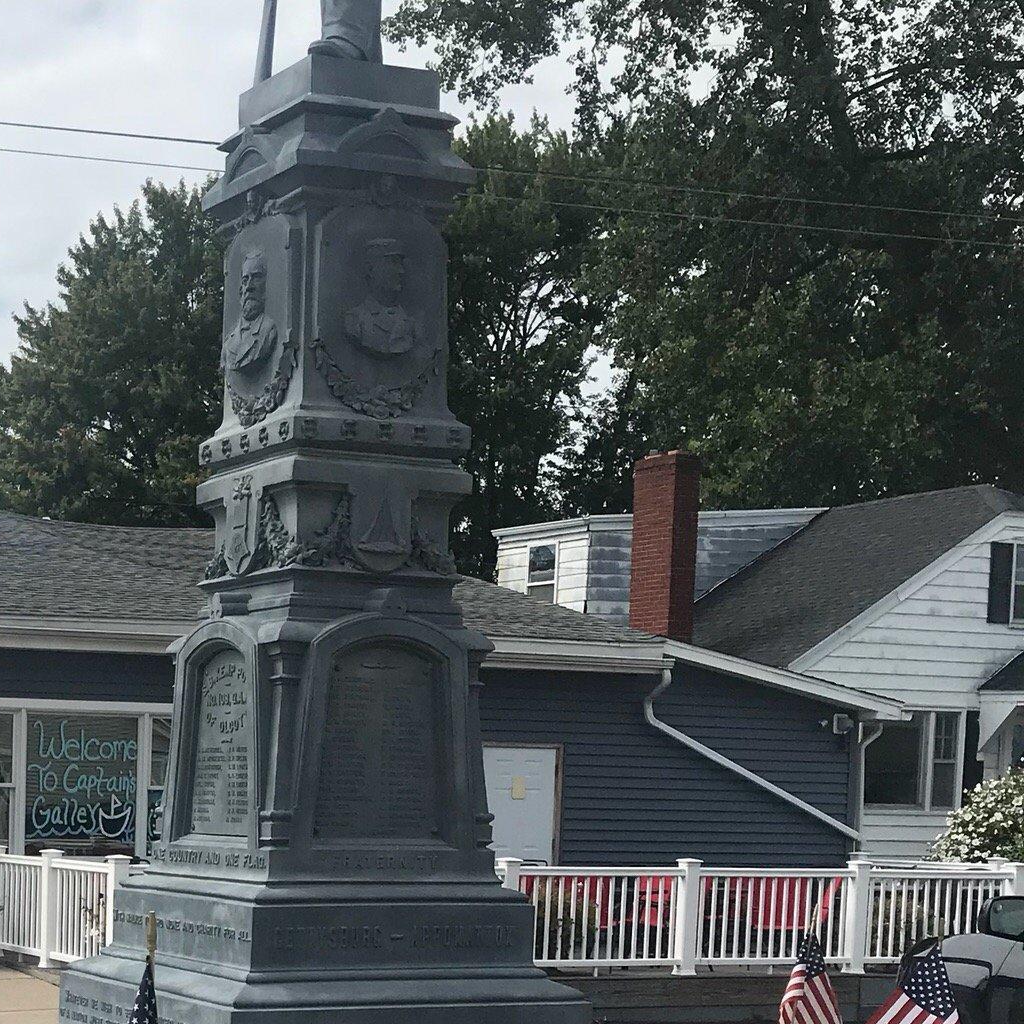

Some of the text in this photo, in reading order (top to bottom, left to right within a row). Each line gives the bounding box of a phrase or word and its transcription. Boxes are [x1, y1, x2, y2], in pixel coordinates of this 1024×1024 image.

[34, 720, 137, 761] Welcome
[27, 761, 136, 799] To Captain's
[32, 795, 101, 834] Galley
[169, 849, 203, 865] COUNTRY
[205, 852, 221, 866] AND
[225, 853, 240, 868] ONE
